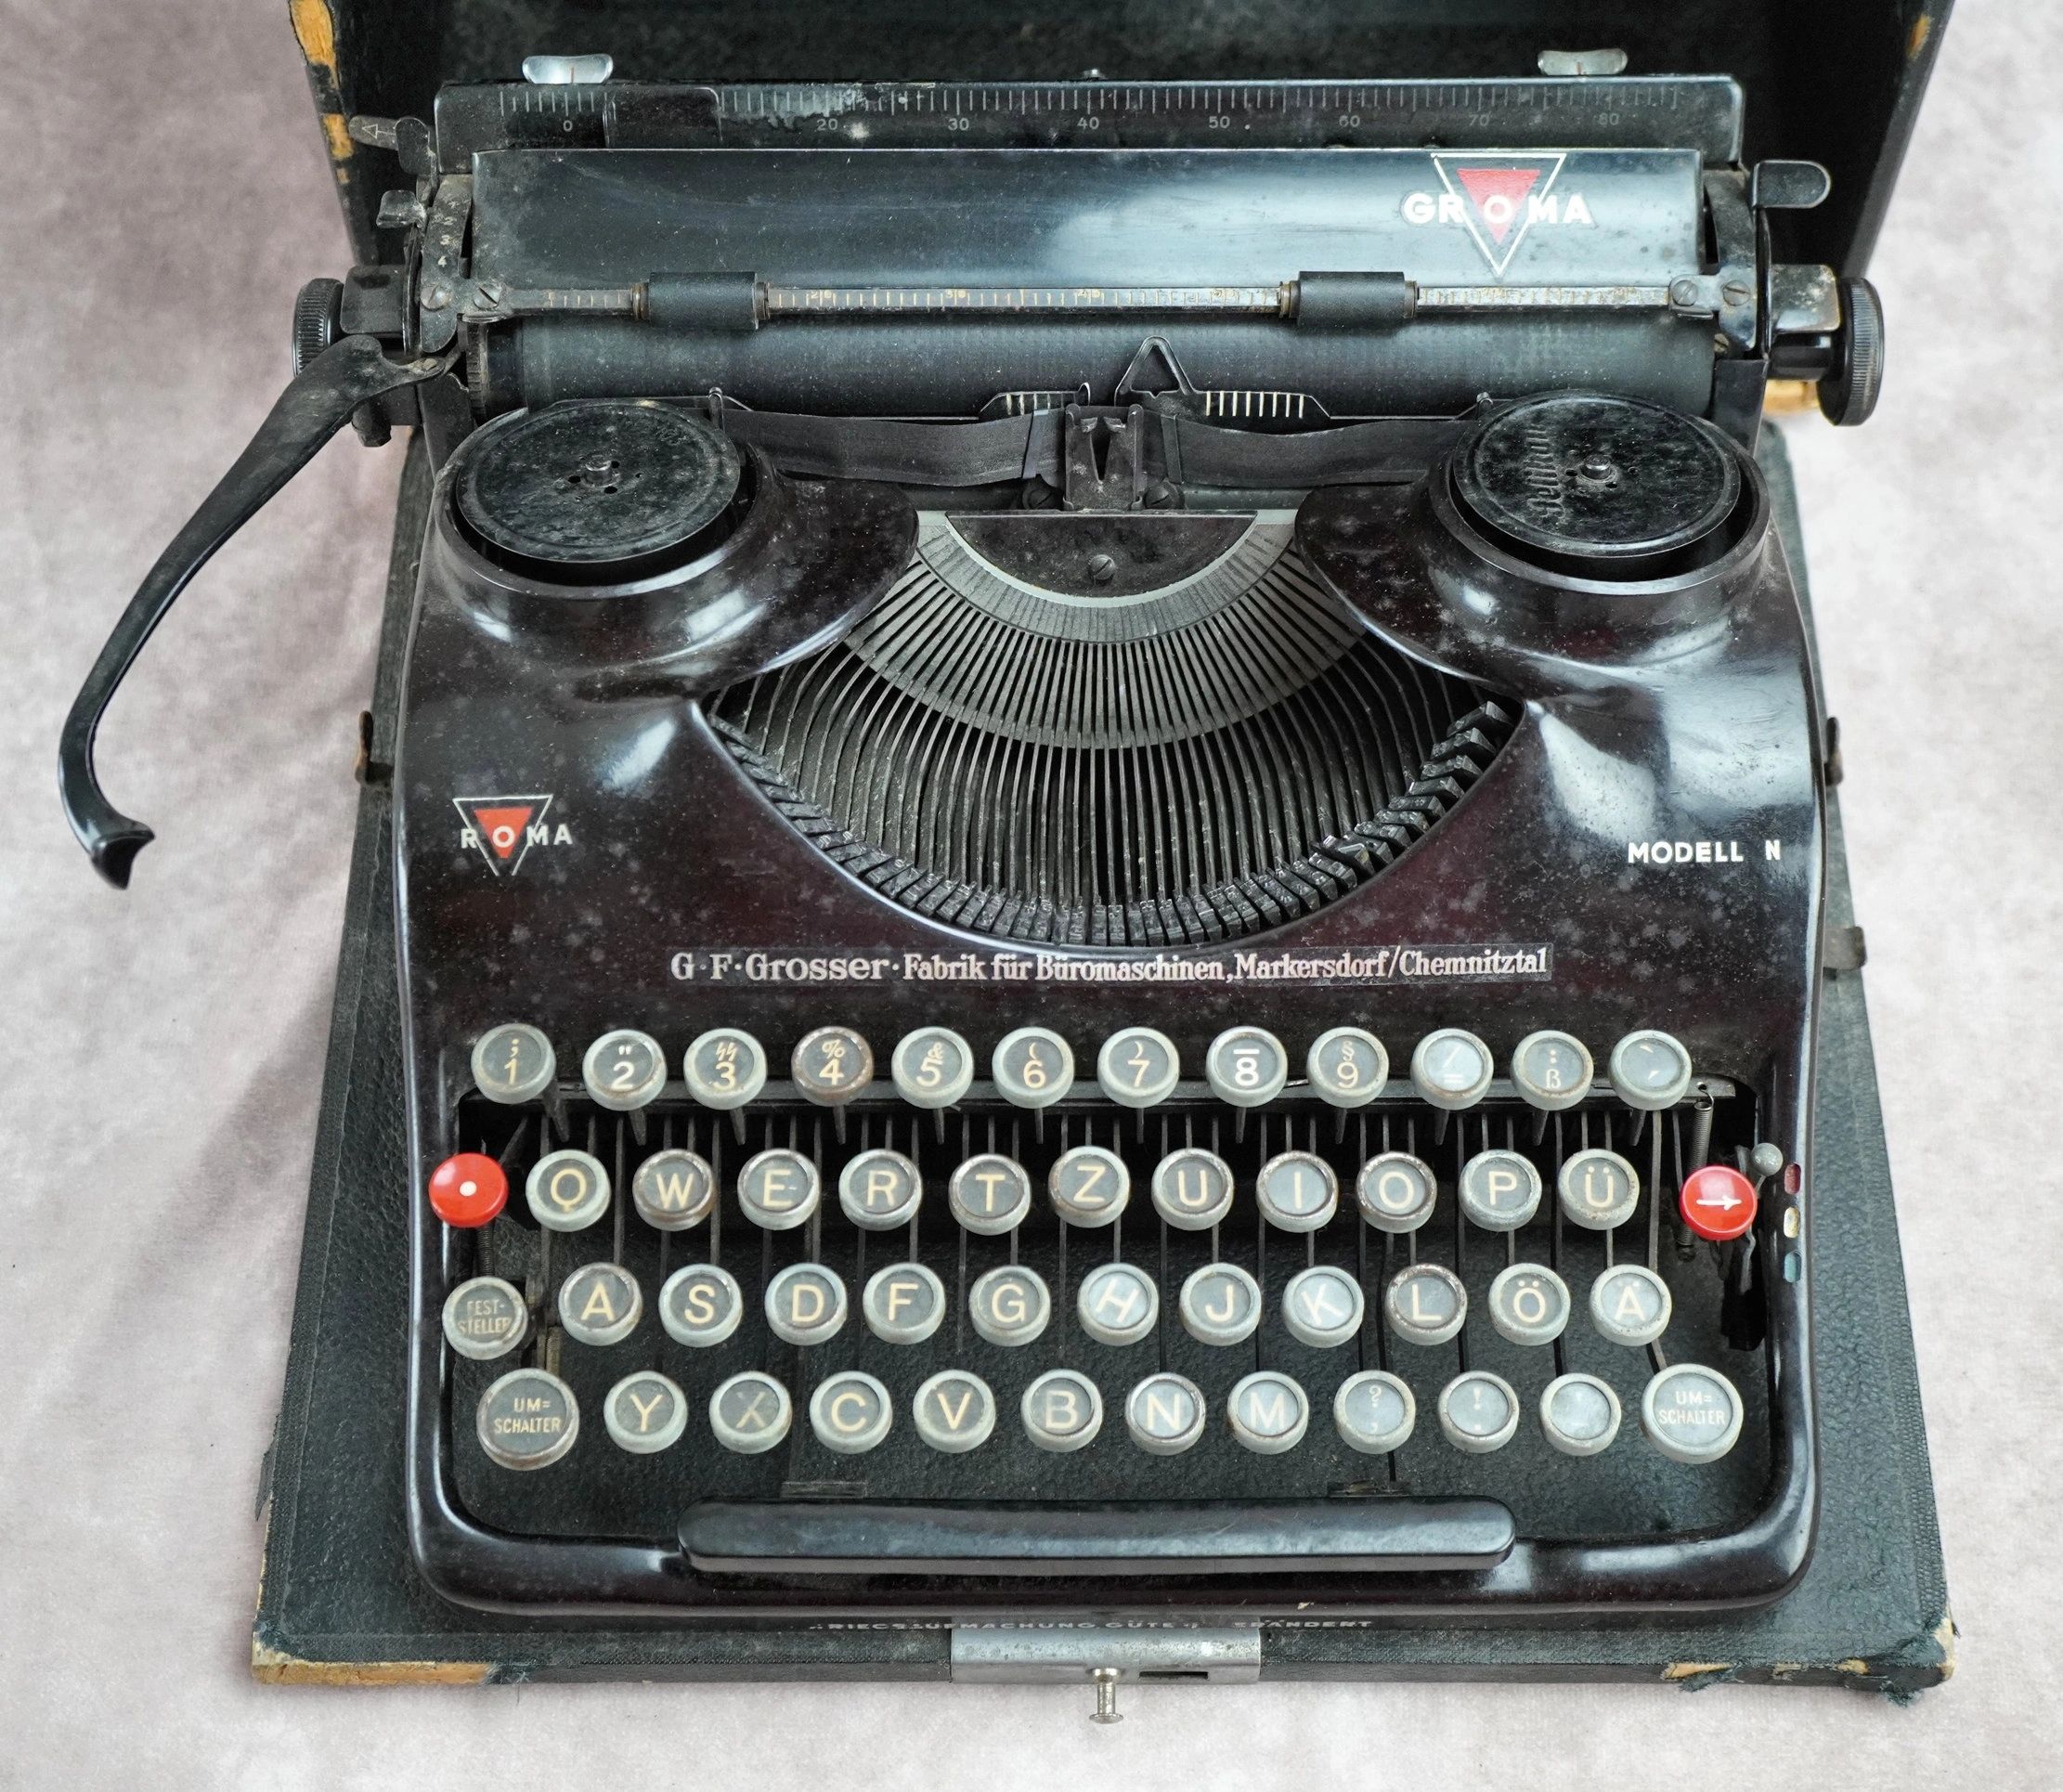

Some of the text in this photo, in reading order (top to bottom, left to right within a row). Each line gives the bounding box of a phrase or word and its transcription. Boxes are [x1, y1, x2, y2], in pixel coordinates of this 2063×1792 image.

[816, 117, 838, 132] 20
[947, 117, 970, 132] 30
[1076, 115, 1100, 131] 40
[1208, 114, 1231, 130] 50
[1467, 112, 1490, 128] 70
[1598, 112, 1620, 126] 80
[1401, 191, 1593, 225] GROMA
[1627, 838, 1781, 864] MODELL N
[902, 953, 988, 980] Fabrik
[991, 953, 1032, 980] für
[503, 1059, 519, 1085] 1
[611, 1060, 635, 1090] 2
[713, 1060, 737, 1091] 3
[818, 1058, 846, 1085] 4
[915, 1057, 943, 1087] 5
[1022, 1058, 1047, 1089] 6
[1126, 1058, 1152, 1088] 7
[1233, 1056, 1260, 1087] 8
[1336, 1060, 1360, 1089] 9
[550, 1167, 588, 1213] Q
[655, 1171, 695, 1210] W
[762, 1168, 794, 1208] E
[865, 1169, 898, 1207] R
[975, 1173, 1006, 1213] T
[1072, 1164, 1107, 1204] Z
[1176, 1169, 1207, 1207] U
[1293, 1171, 1303, 1209] I
[1378, 1170, 1415, 1210] O
[1487, 1170, 1518, 1206] P
[1584, 1165, 1615, 1208] Ü
[579, 1281, 616, 1322] A
[684, 1284, 717, 1325] S
[790, 1283, 825, 1323] D
[888, 1282, 919, 1321] F
[991, 1282, 1027, 1323] G
[1094, 1278, 1140, 1324] H
[1204, 1283, 1235, 1322] J
[1301, 1282, 1346, 1327] K
[1410, 1282, 1444, 1321] L
[1512, 1279, 1547, 1324] Ö
[1614, 1279, 1647, 1322] Ä
[493, 1416, 562, 1435] SCHALTER
[628, 1393, 665, 1433] Y
[734, 1389, 769, 1430] X
[830, 1391, 868, 1433] C
[936, 1391, 972, 1431] V
[1044, 1389, 1080, 1431] B
[1146, 1392, 1182, 1432] N
[1248, 1391, 1287, 1430] M
[1657, 1408, 1727, 1427] SCHALTER
